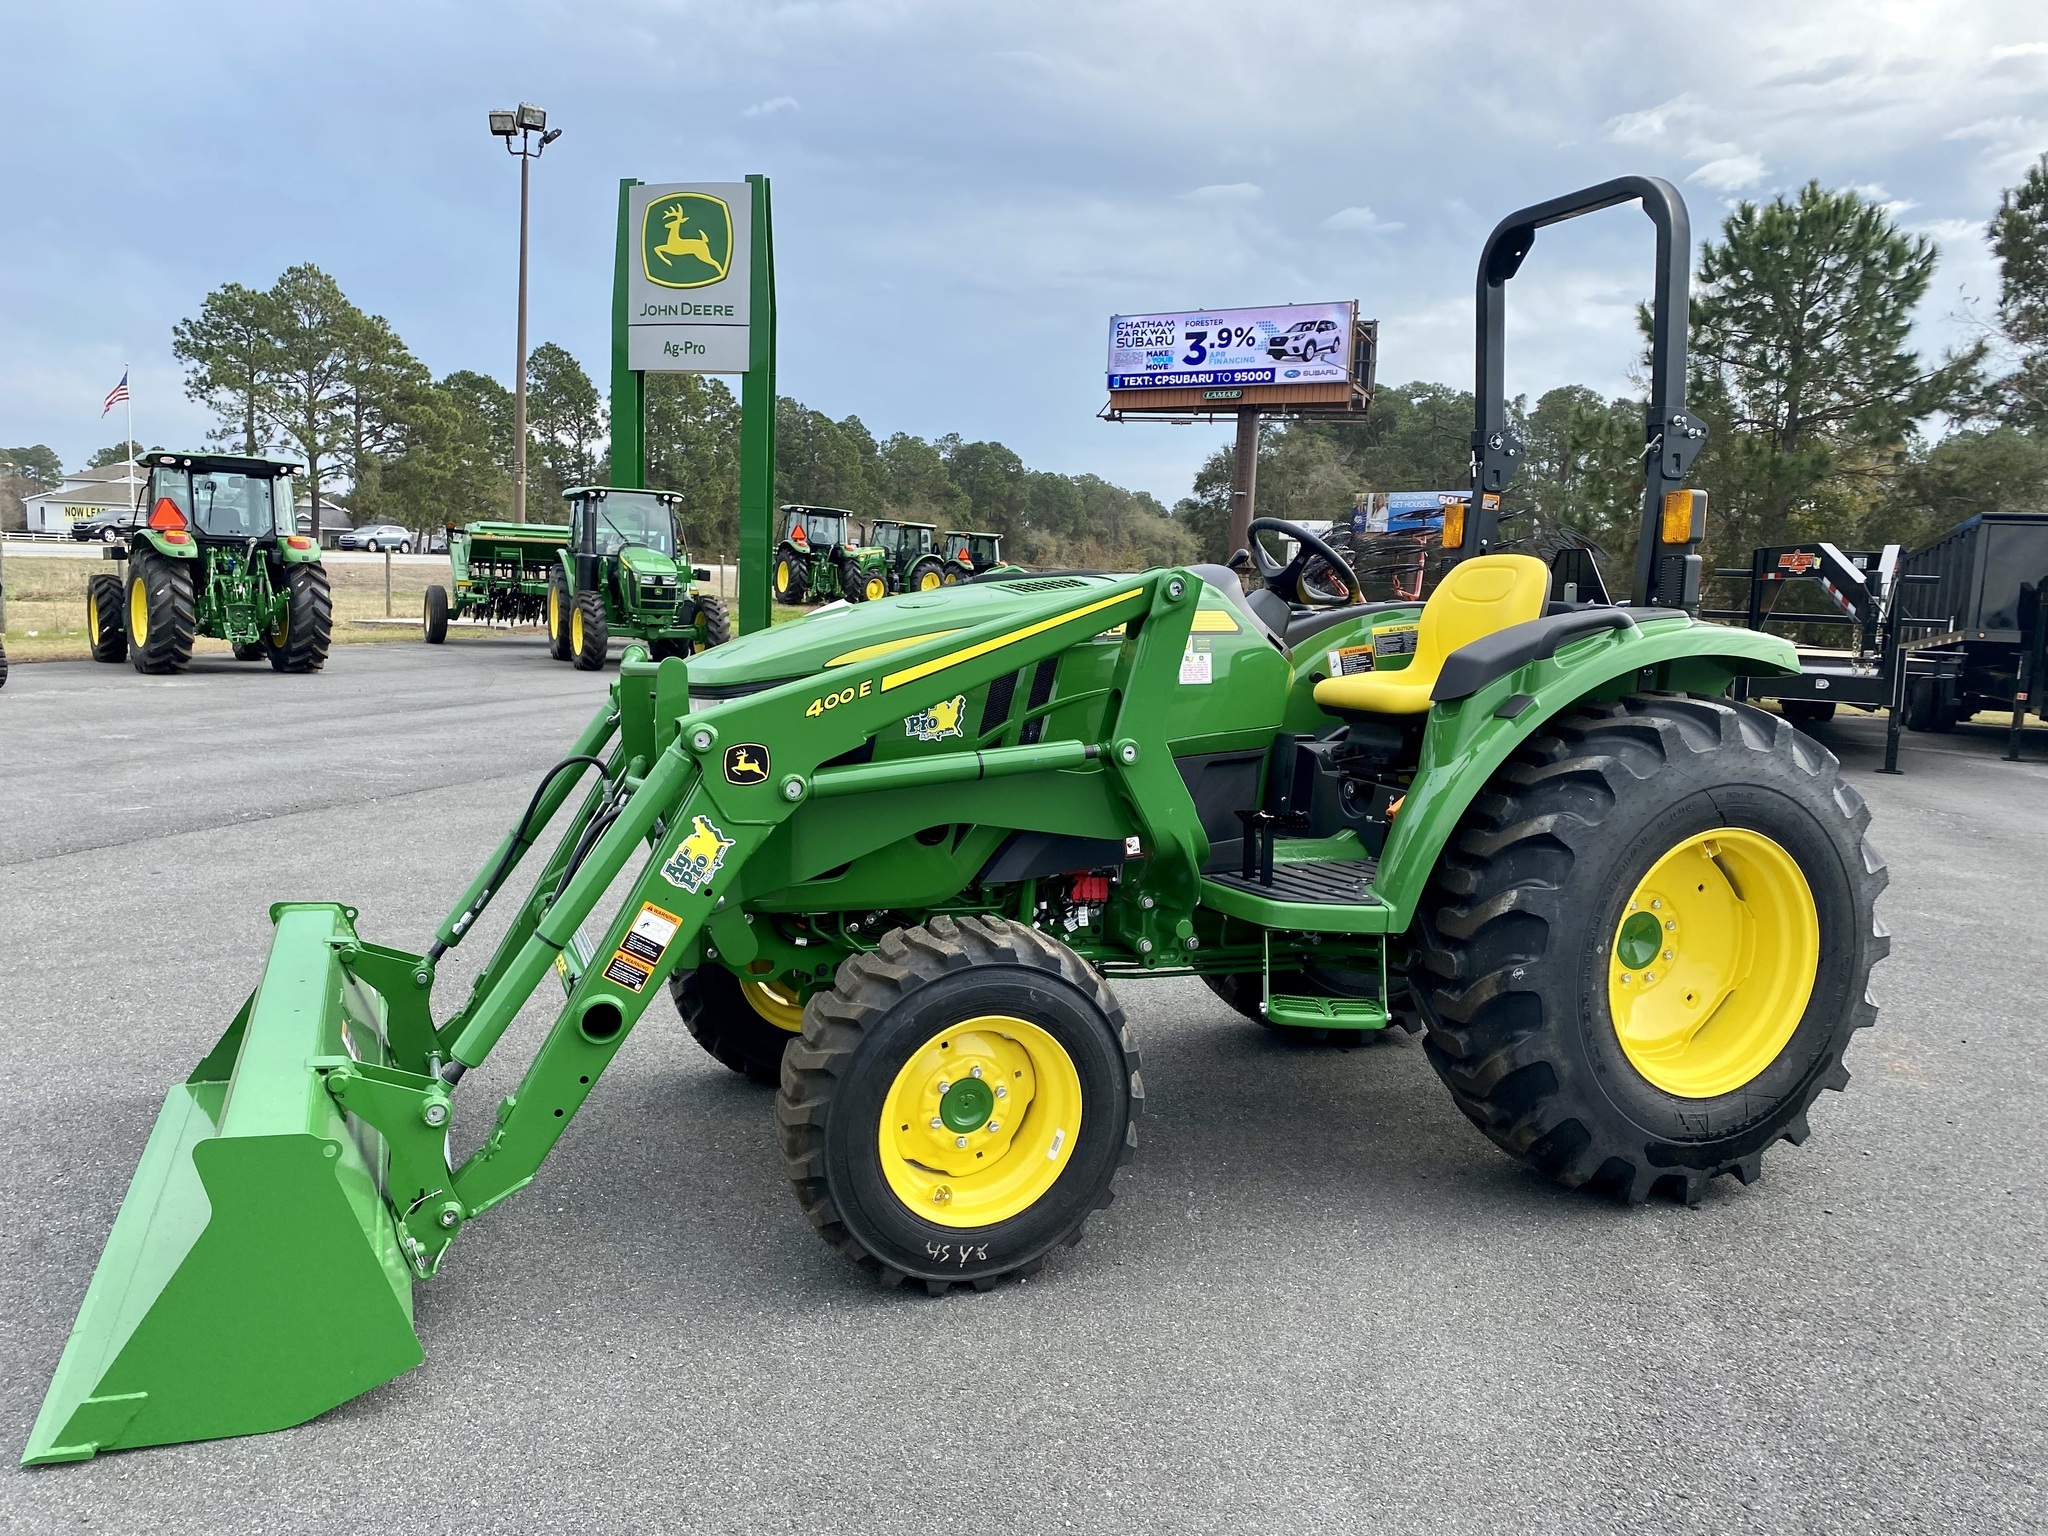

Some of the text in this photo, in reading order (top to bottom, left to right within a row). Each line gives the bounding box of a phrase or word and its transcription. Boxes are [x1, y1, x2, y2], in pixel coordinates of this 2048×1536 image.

[640, 302, 734, 316] JOHN DEERE
[1117, 320, 1175, 330] CHATHAM
[1185, 319, 1223, 327] FORESTER
[1116, 327, 1175, 337] PARKWAY
[1116, 335, 1175, 348] SUBARU
[1182, 326, 1256, 366] 3.9%
[663, 341, 706, 357] Ag-Pro
[1209, 357, 1256, 365] FINANCING
[1123, 370, 1272, 386] TEXT: CPSUBARU TO 95000
[65, 506, 84, 517] NOW
[805, 679, 873, 718] 400 E
[653, 908, 678, 923] WARNING
[625, 957, 650, 972] WARNING
